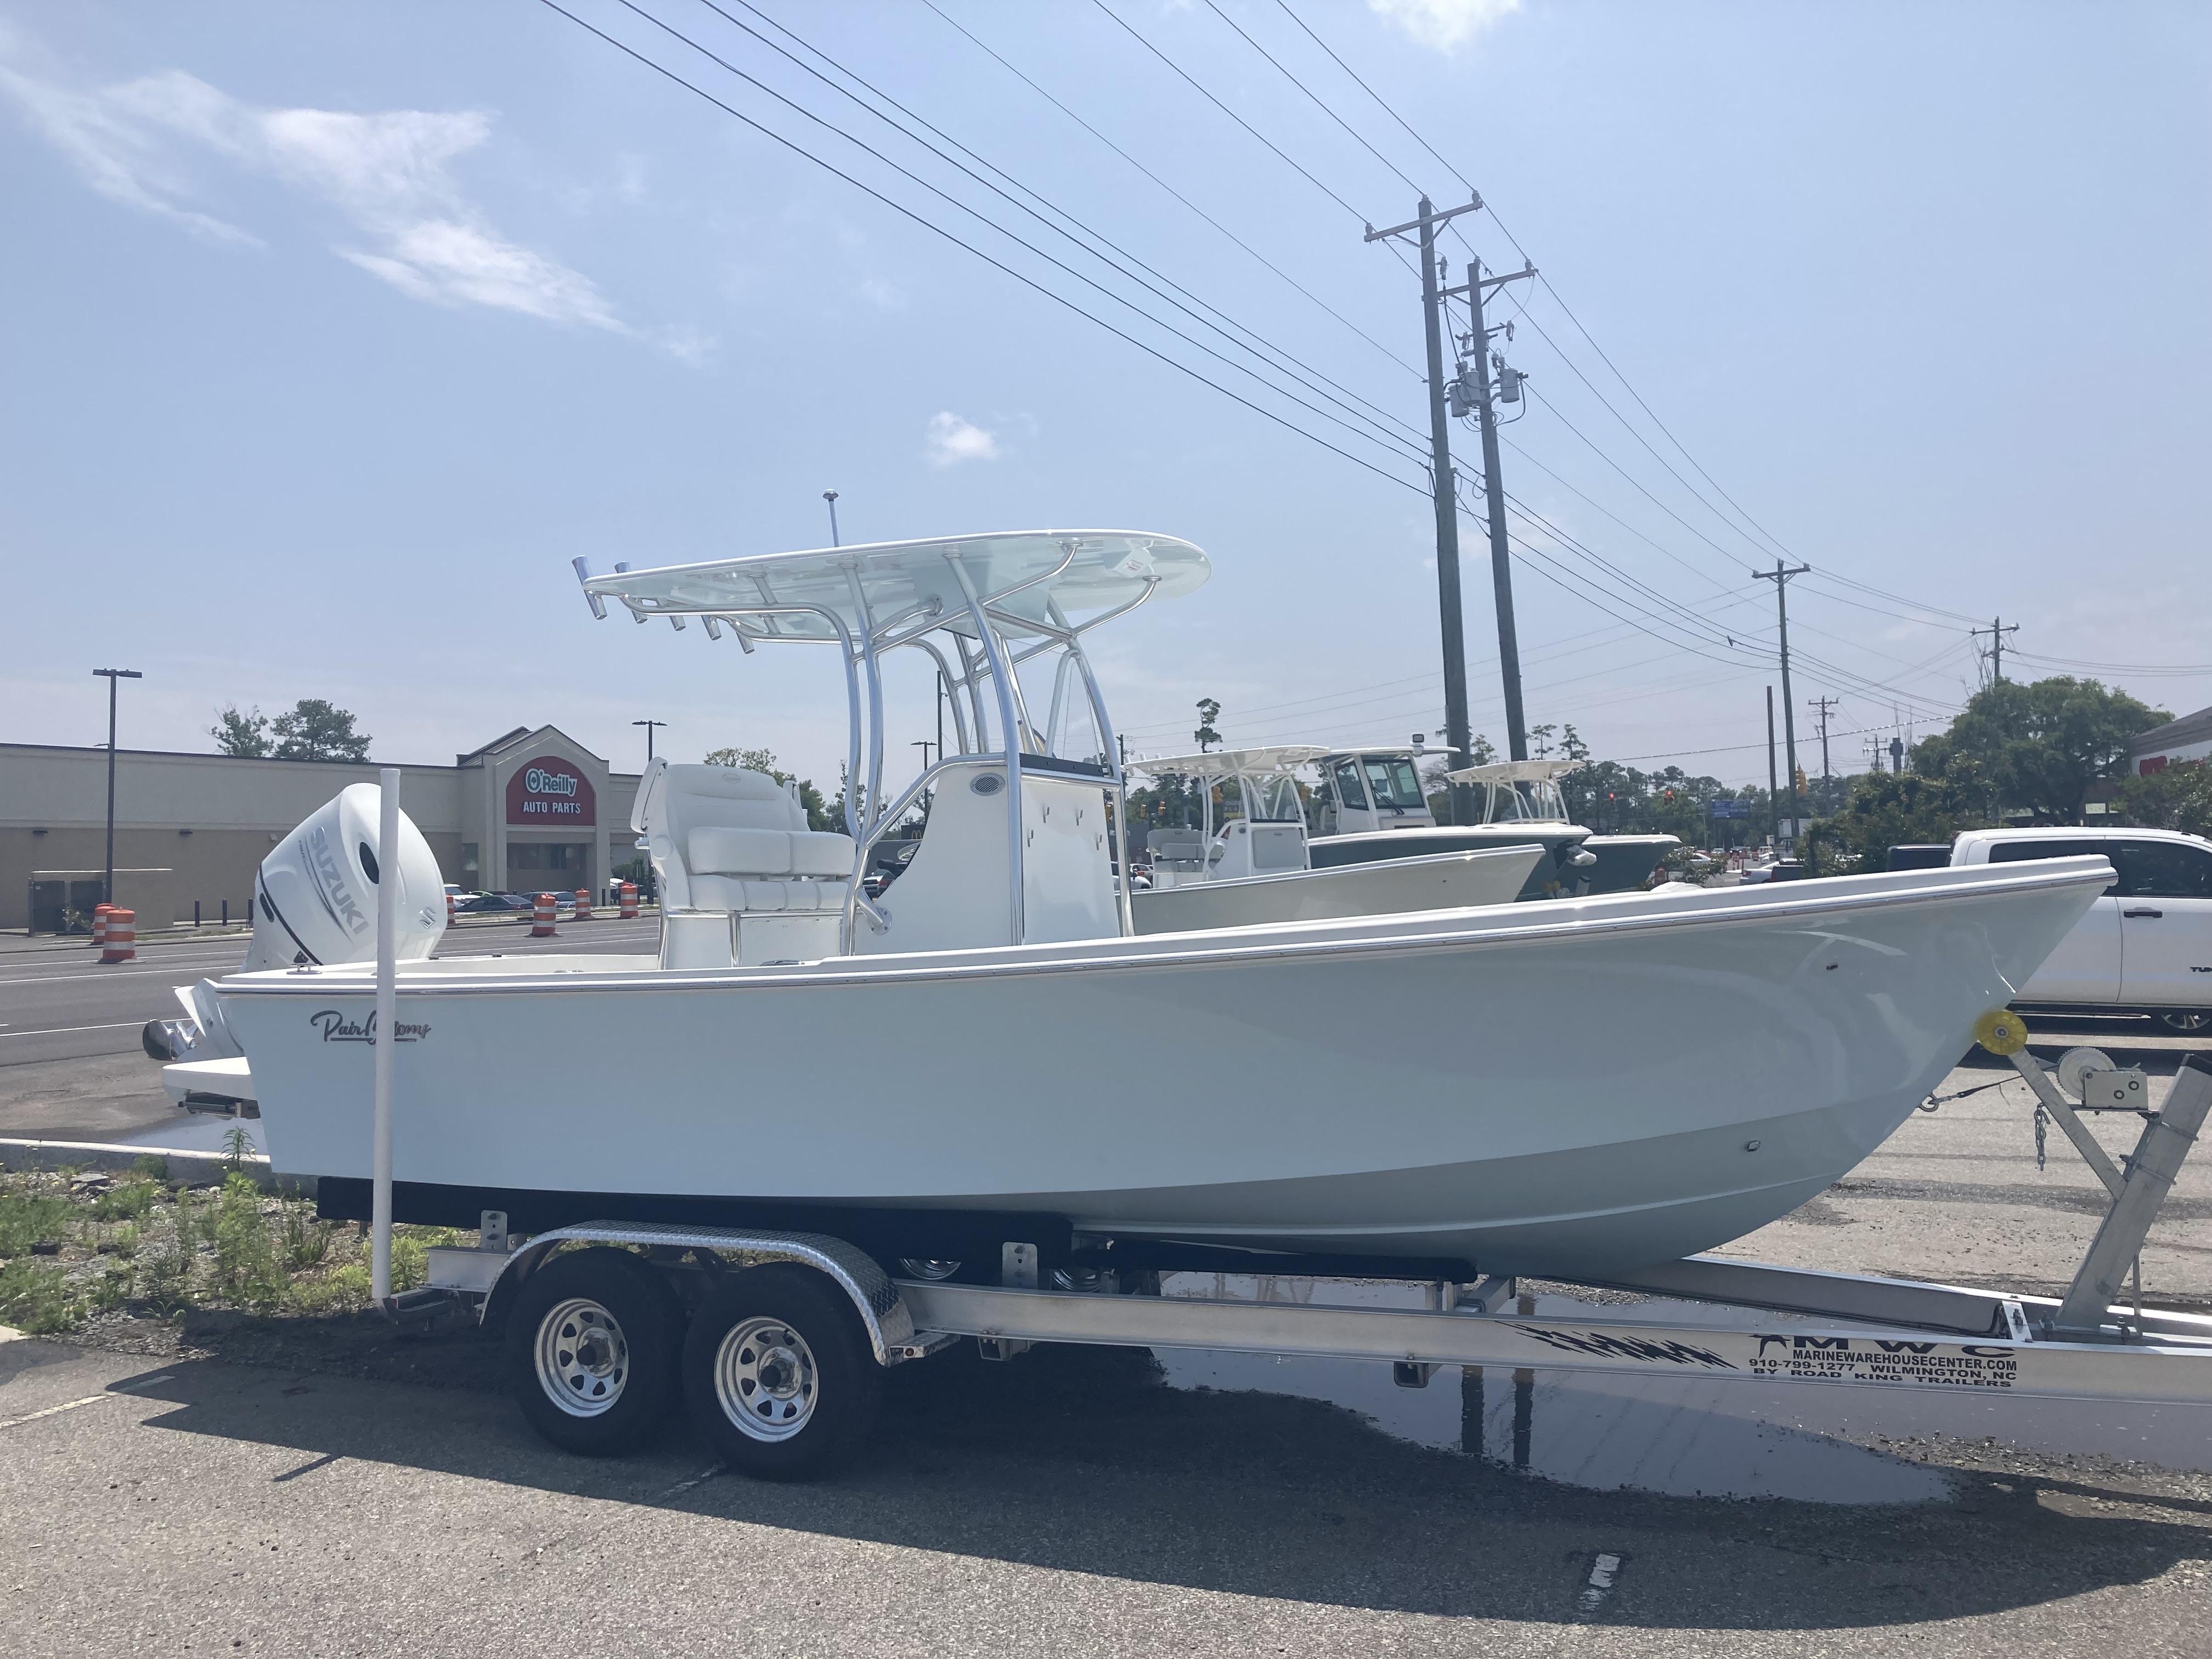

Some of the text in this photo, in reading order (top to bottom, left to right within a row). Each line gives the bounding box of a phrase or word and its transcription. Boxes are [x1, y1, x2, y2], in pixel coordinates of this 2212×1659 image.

[527, 769, 577, 796] O'Reilly
[523, 802, 580, 814] AUTO PARTS
[310, 827, 370, 935] SUZUKI
[1749, 1359, 2017, 1380] 910-799-1277 WILMINGTON, NC
[1793, 1349, 2017, 1371] MARINEWAREHOUSECENTER.COM
[1790, 1369, 1842, 1378] ROAD
[1854, 1373, 1903, 1381] KING
[1914, 1376, 2012, 1387] TRAILERS
